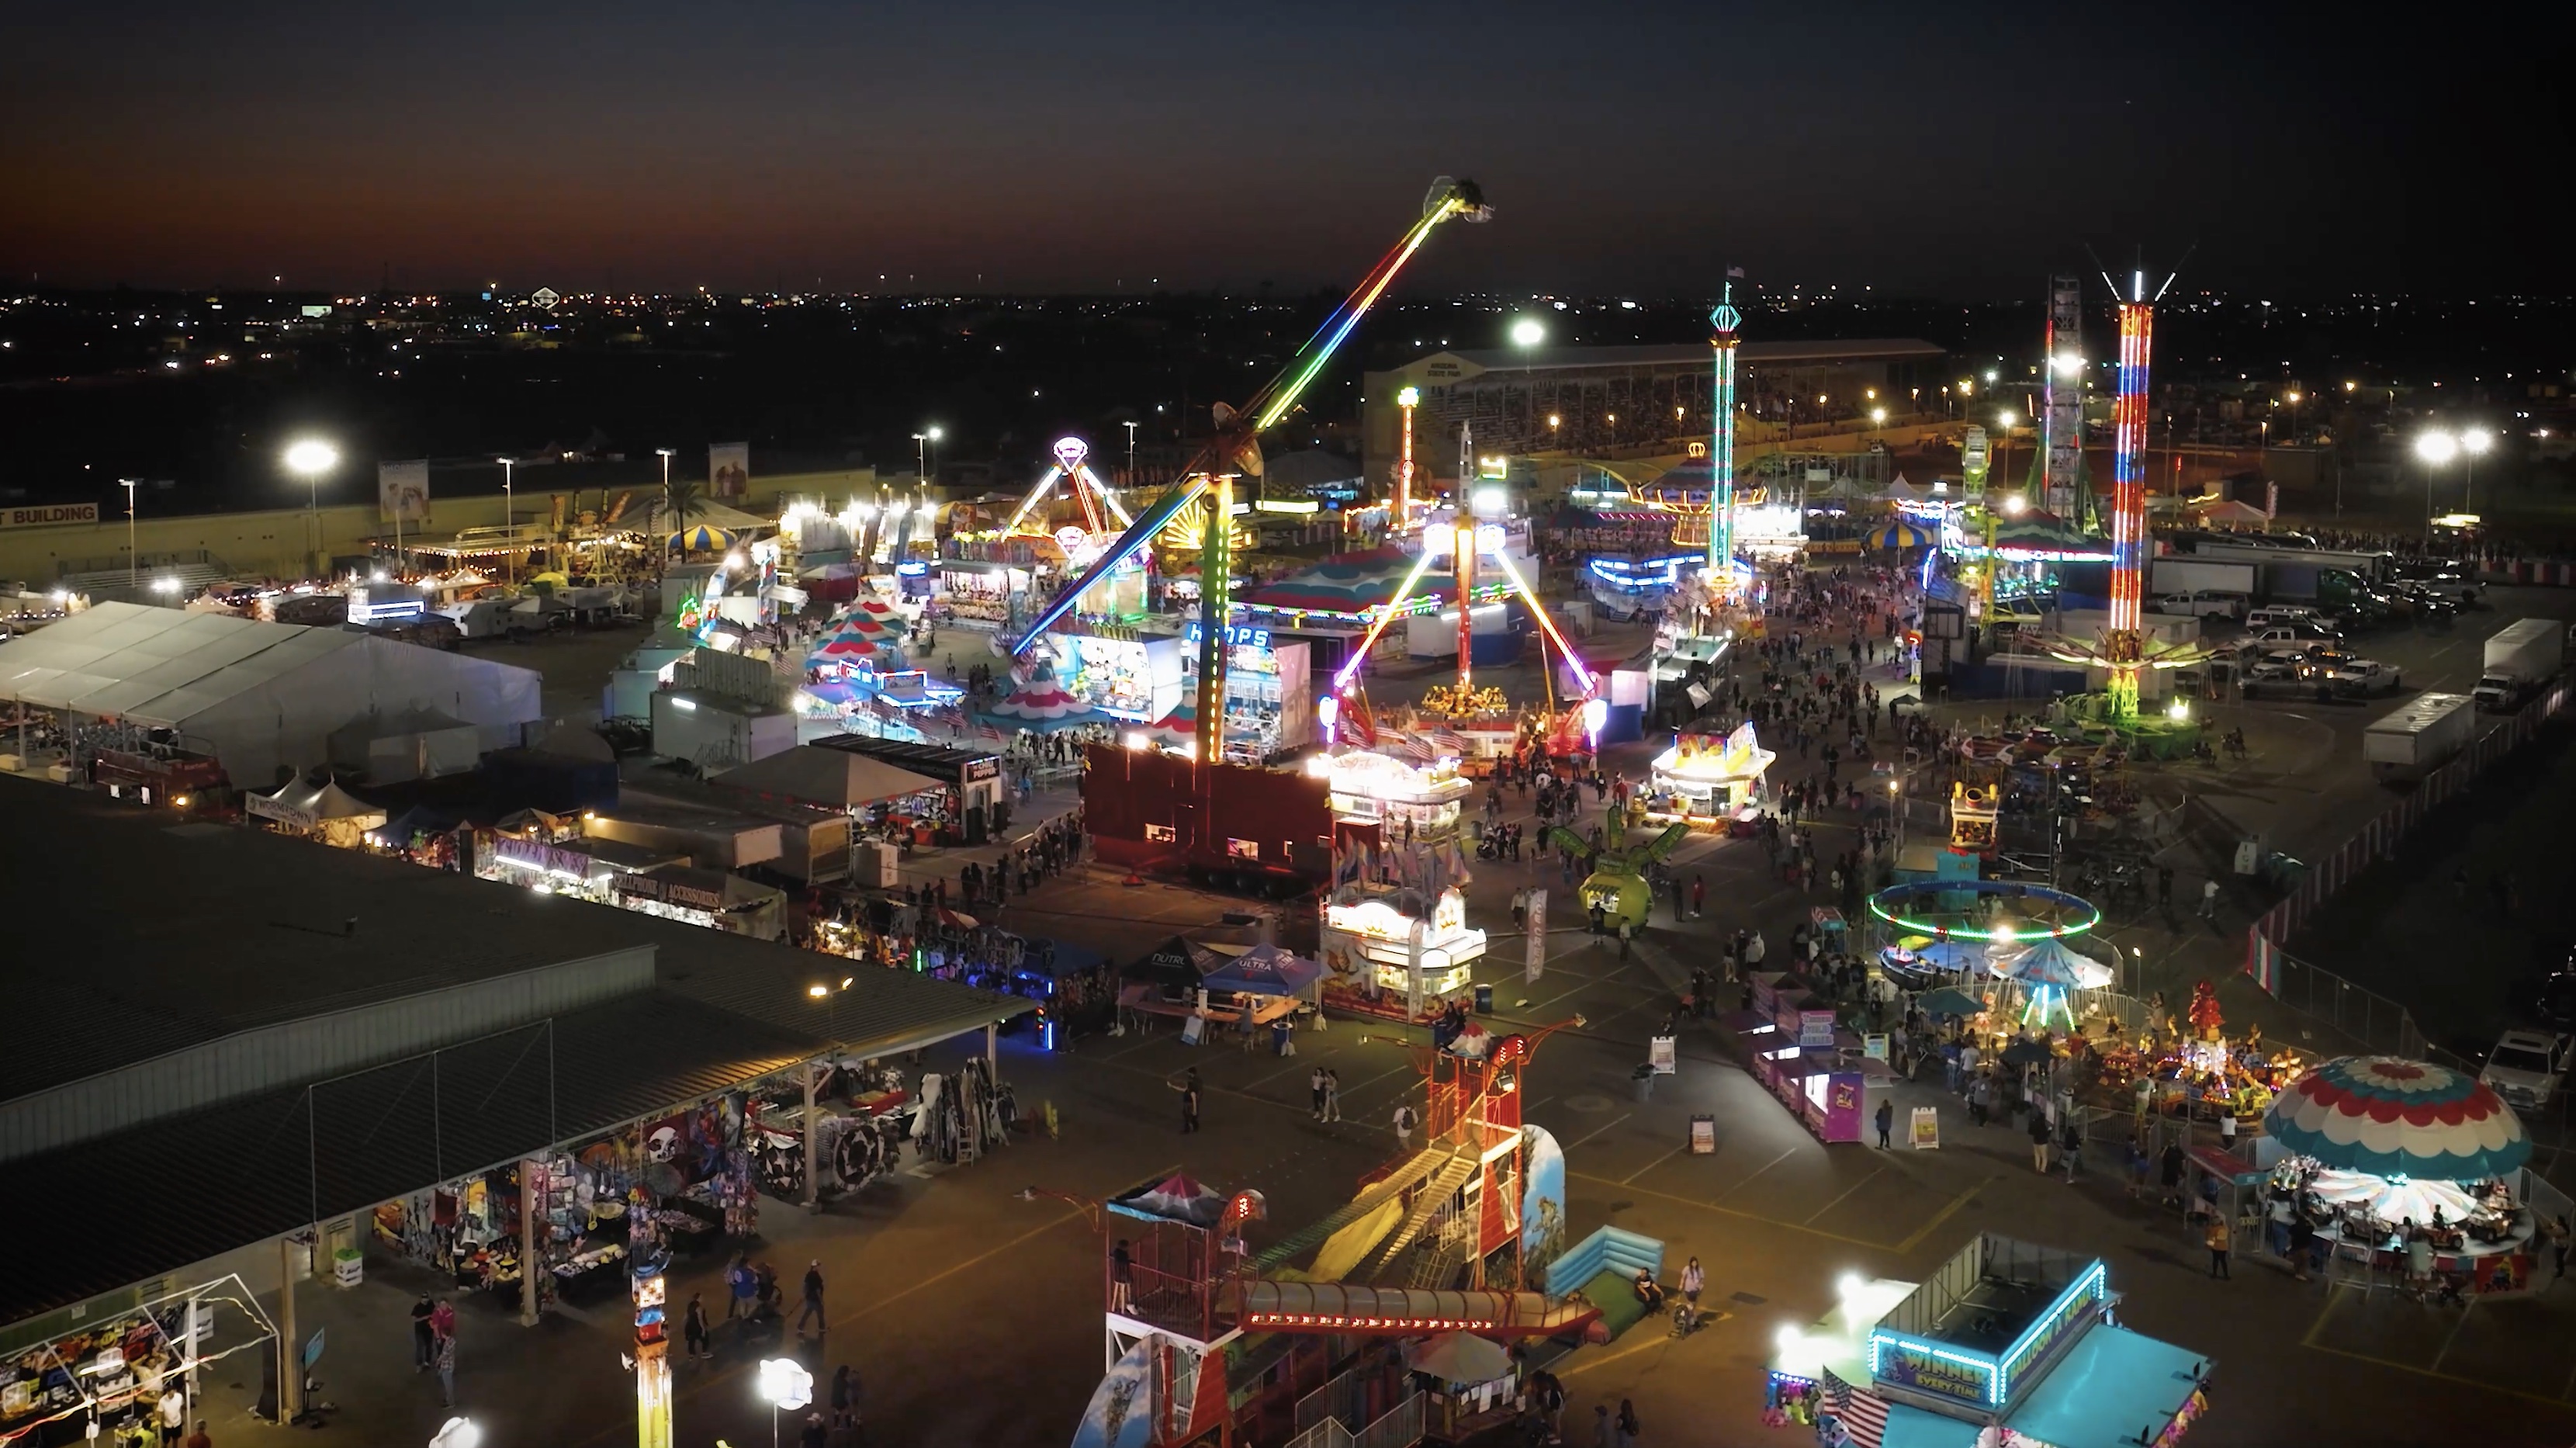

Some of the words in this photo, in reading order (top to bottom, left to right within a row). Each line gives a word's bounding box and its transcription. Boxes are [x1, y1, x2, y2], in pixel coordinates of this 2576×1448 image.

[13, 506, 95, 525] BUILDING
[973, 767, 996, 778] PEPPER
[978, 760, 994, 771] CHILI
[667, 883, 722, 909] ACCESSORIES
[1531, 927, 1542, 977] CREAM
[1238, 959, 1272, 972] ULTRA
[2010, 1324, 2053, 1384] BALLOON
[2055, 1316, 2062, 1335] A
[1904, 1351, 1984, 1385] WINNER
[1916, 1373, 1953, 1393] EVERY
